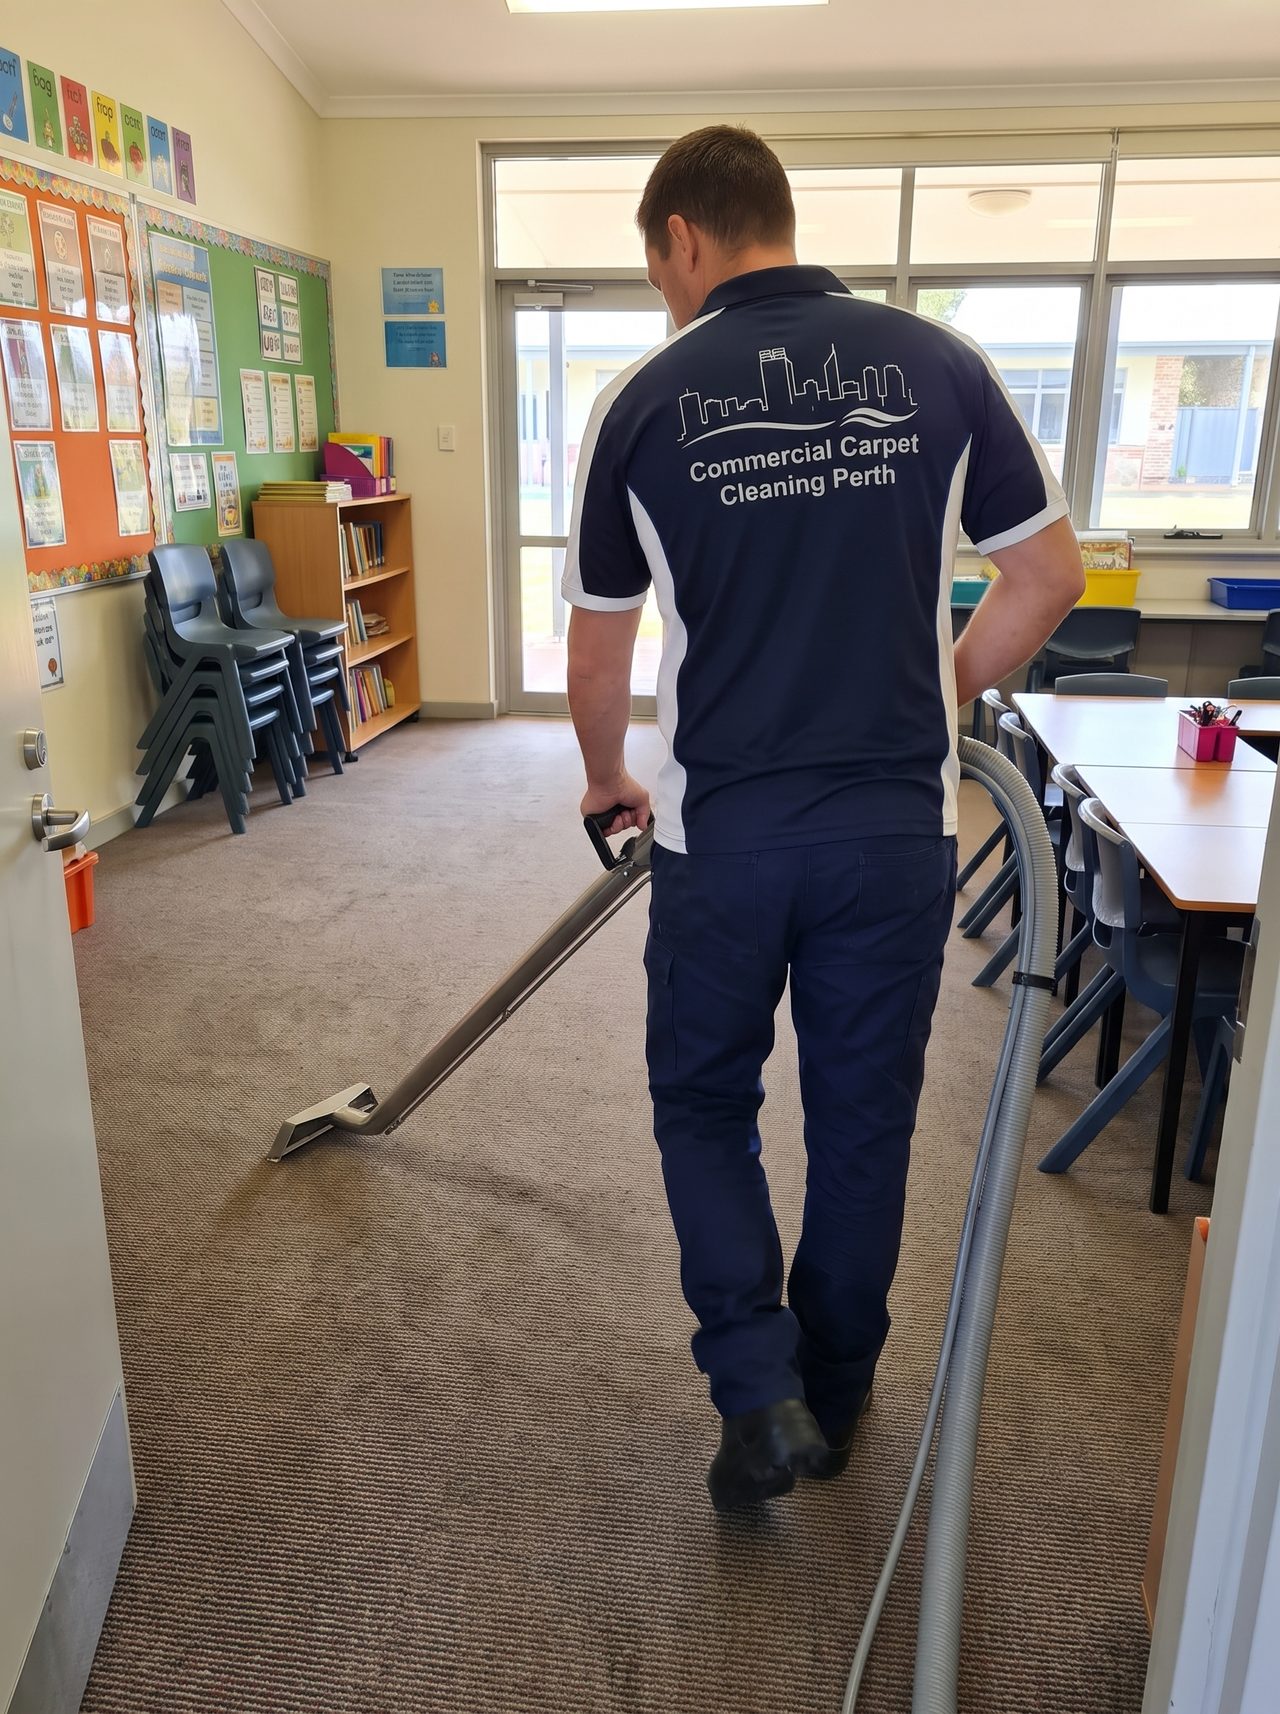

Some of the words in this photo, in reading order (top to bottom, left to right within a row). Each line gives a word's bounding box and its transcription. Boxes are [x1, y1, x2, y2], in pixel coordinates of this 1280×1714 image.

[690, 439, 832, 482] Commercial
[840, 434, 919, 459] Carpet
[720, 475, 826, 506] Cleaning
[832, 464, 896, 489] Perth
